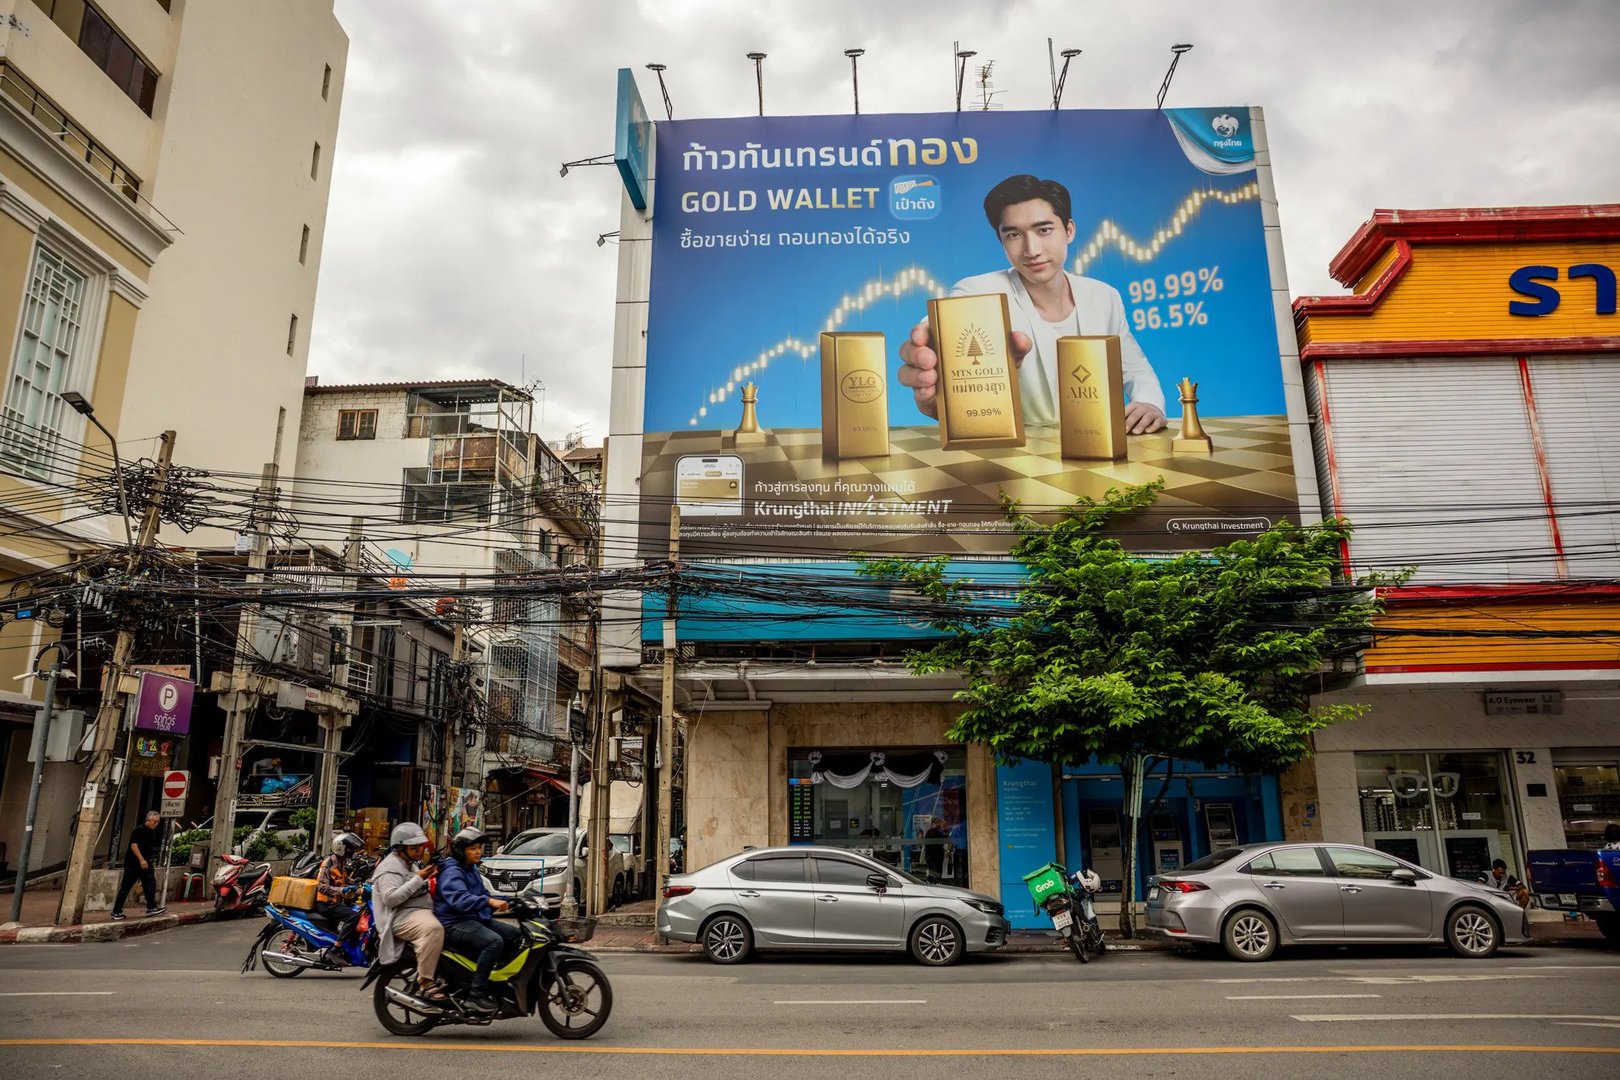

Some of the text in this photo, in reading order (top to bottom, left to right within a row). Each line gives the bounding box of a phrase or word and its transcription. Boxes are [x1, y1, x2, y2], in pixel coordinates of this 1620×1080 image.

[1213, 138, 1242, 149] กรุงไทย
[681, 187, 880, 213] GOLD WALLET
[680, 226, 911, 248] ซื้อขายง่าย ถอนทองได้จริง
[1128, 266, 1224, 304] 99.99%
[1132, 301, 1208, 331] 96.5%
[951, 367, 1004, 377] MTS GOLD
[848, 376, 876, 386] YLG
[952, 380, 1006, 395] แม่ทองสุก
[966, 408, 1002, 418] 99.99%
[754, 480, 831, 496] ก้าวสู่การลงทุน
[754, 496, 953, 519] Krungthai INVESTMENT
[1182, 521, 1264, 531] Krungthai Investment
[1516, 751, 1536, 764] 32
[1035, 879, 1055, 893] Grab
